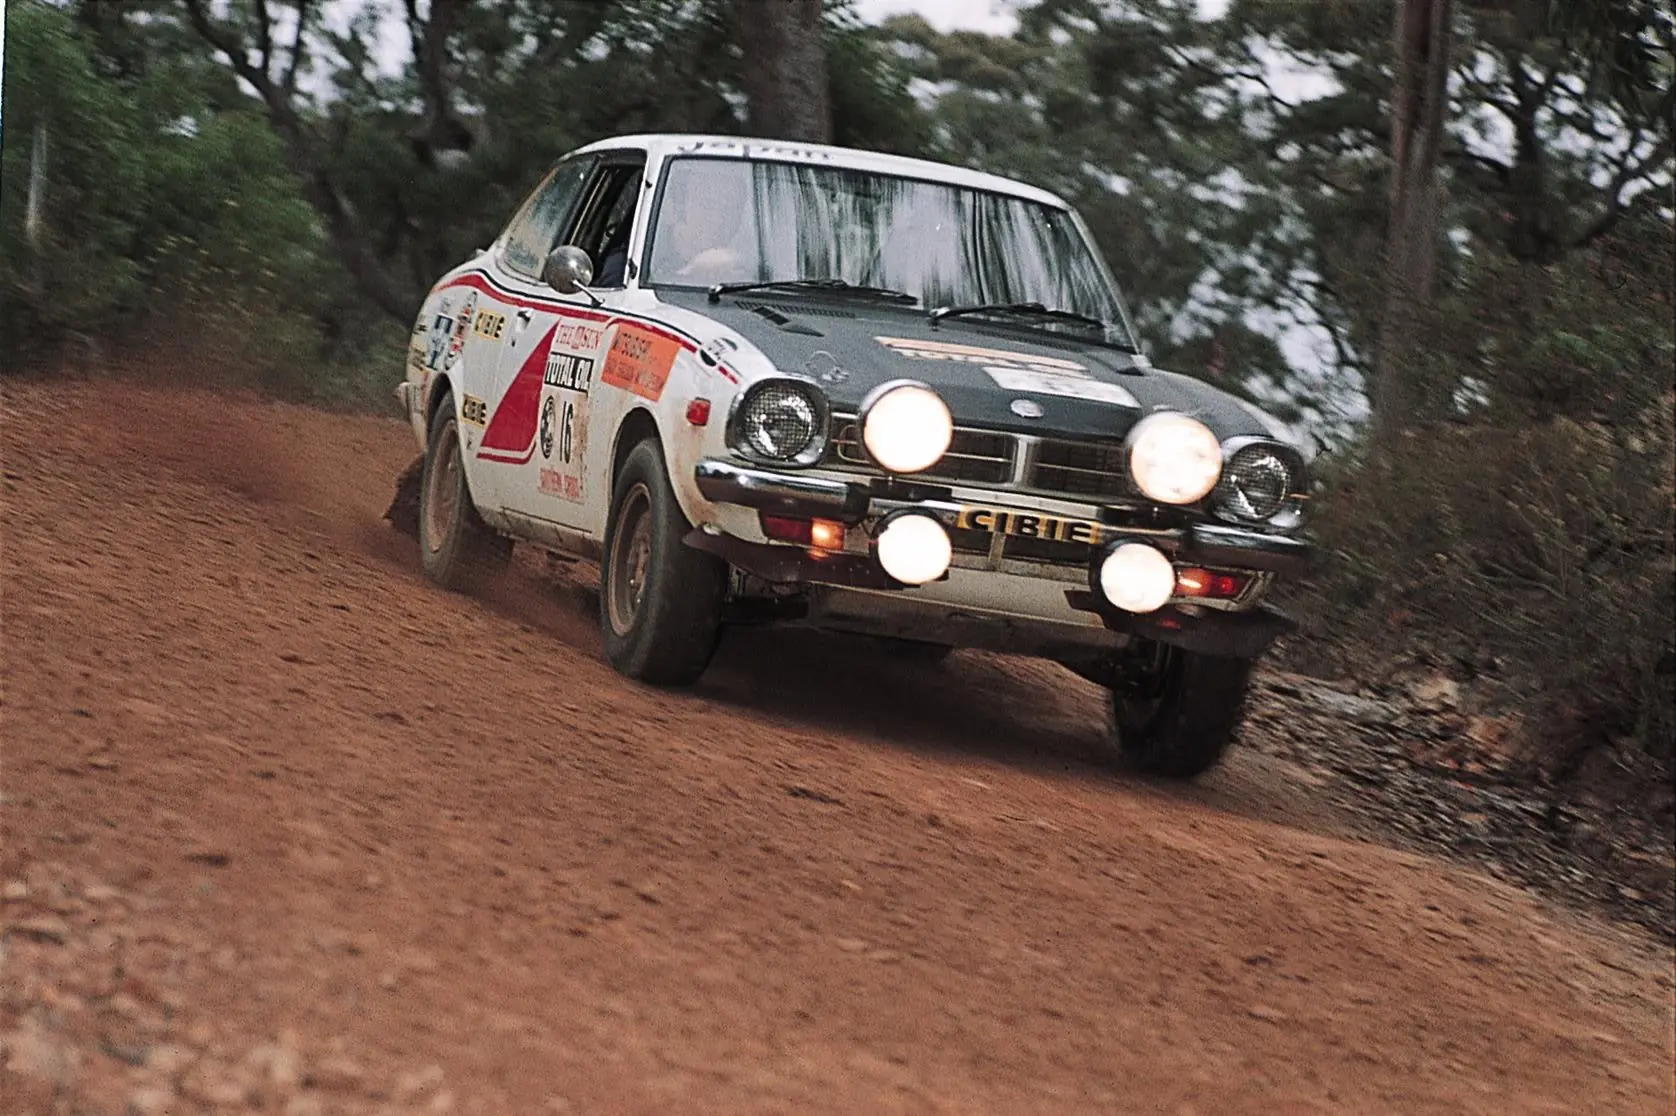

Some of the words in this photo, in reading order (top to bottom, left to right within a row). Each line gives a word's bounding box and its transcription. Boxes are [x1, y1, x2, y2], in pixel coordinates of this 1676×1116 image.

[474, 311, 505, 339] CIBIE
[546, 354, 575, 387] TOTAL
[574, 358, 593, 391] OIL
[560, 401, 574, 464] 16
[966, 508, 1094, 542] CIBIE
